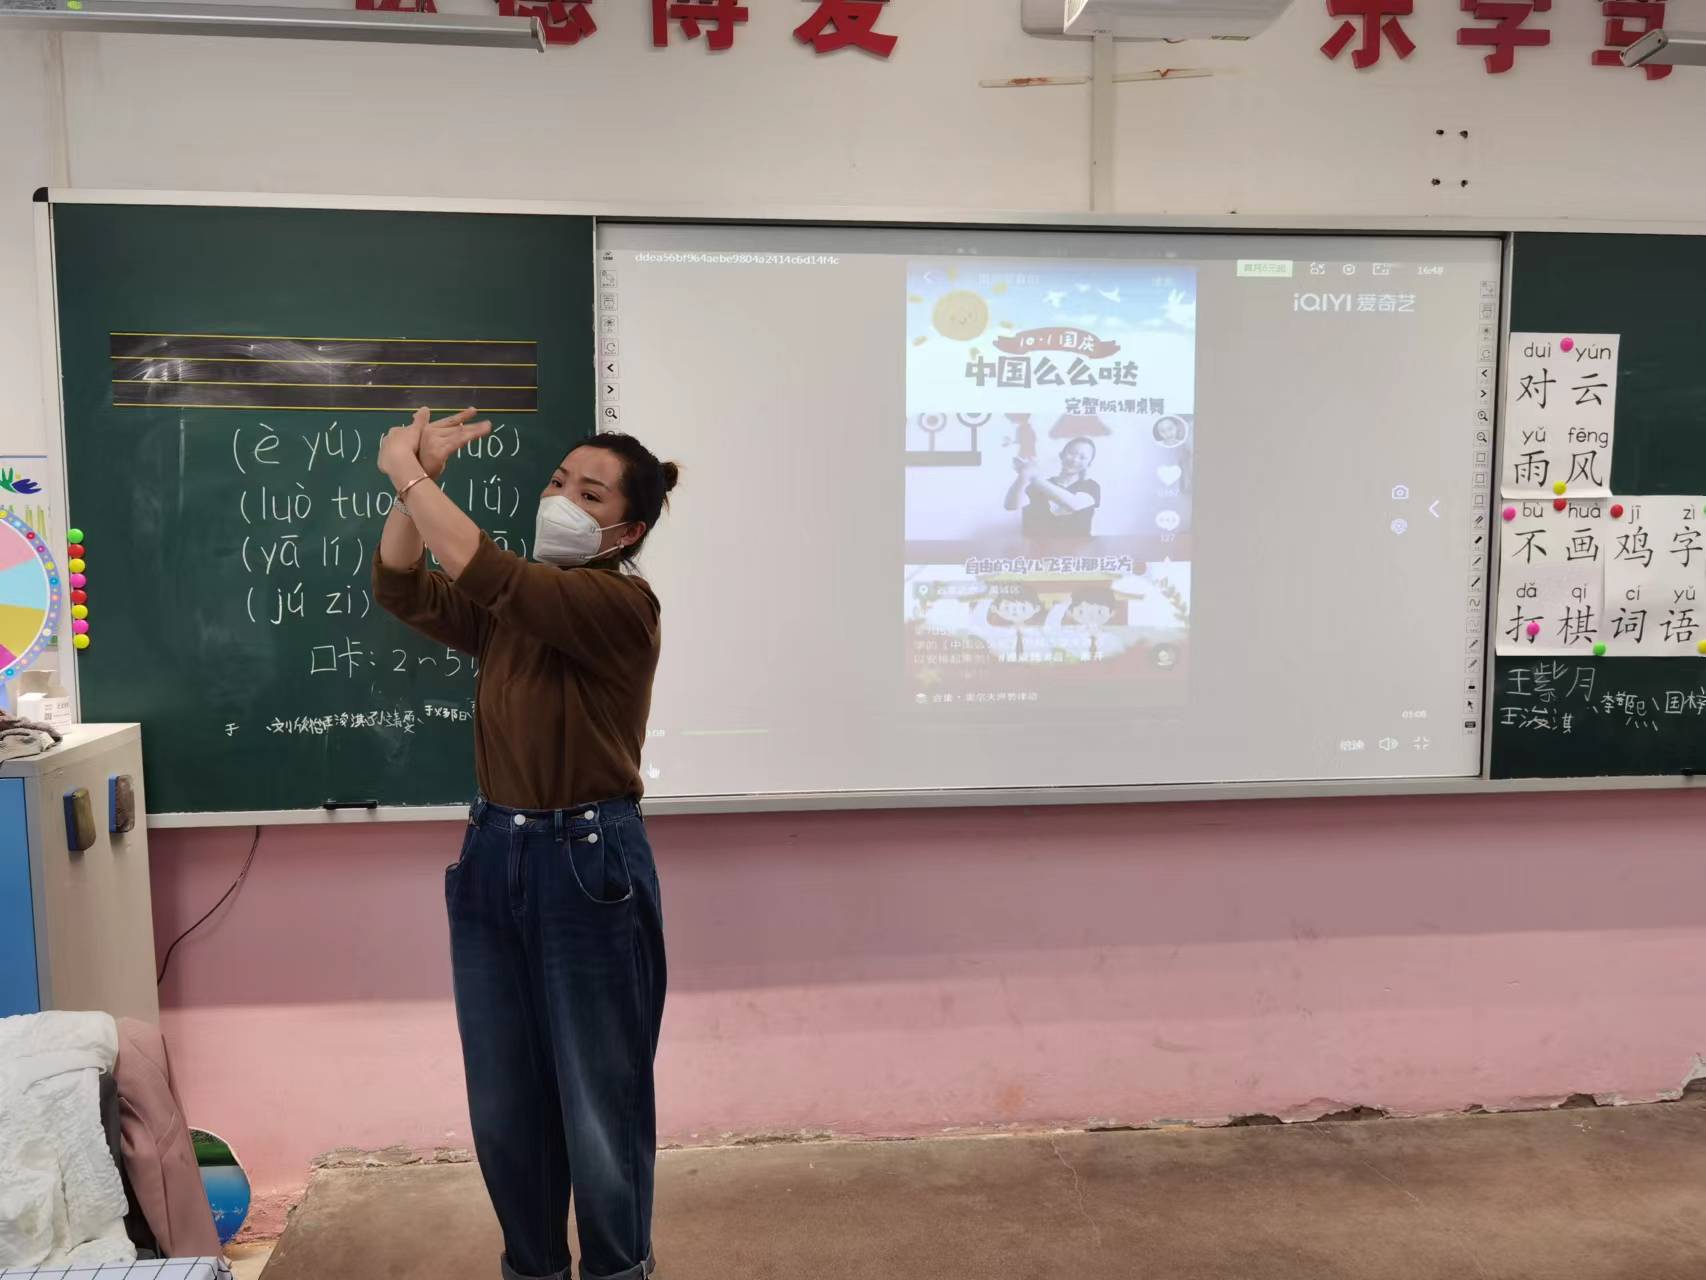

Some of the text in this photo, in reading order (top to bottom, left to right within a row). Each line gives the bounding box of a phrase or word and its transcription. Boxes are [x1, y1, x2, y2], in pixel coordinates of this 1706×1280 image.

[1293, 293, 1416, 312] iQIYI 爱奇艺
[1575, 343, 1612, 363] yún
[965, 356, 1139, 388] 中国么么哒
[1567, 426, 1609, 449] fēng
